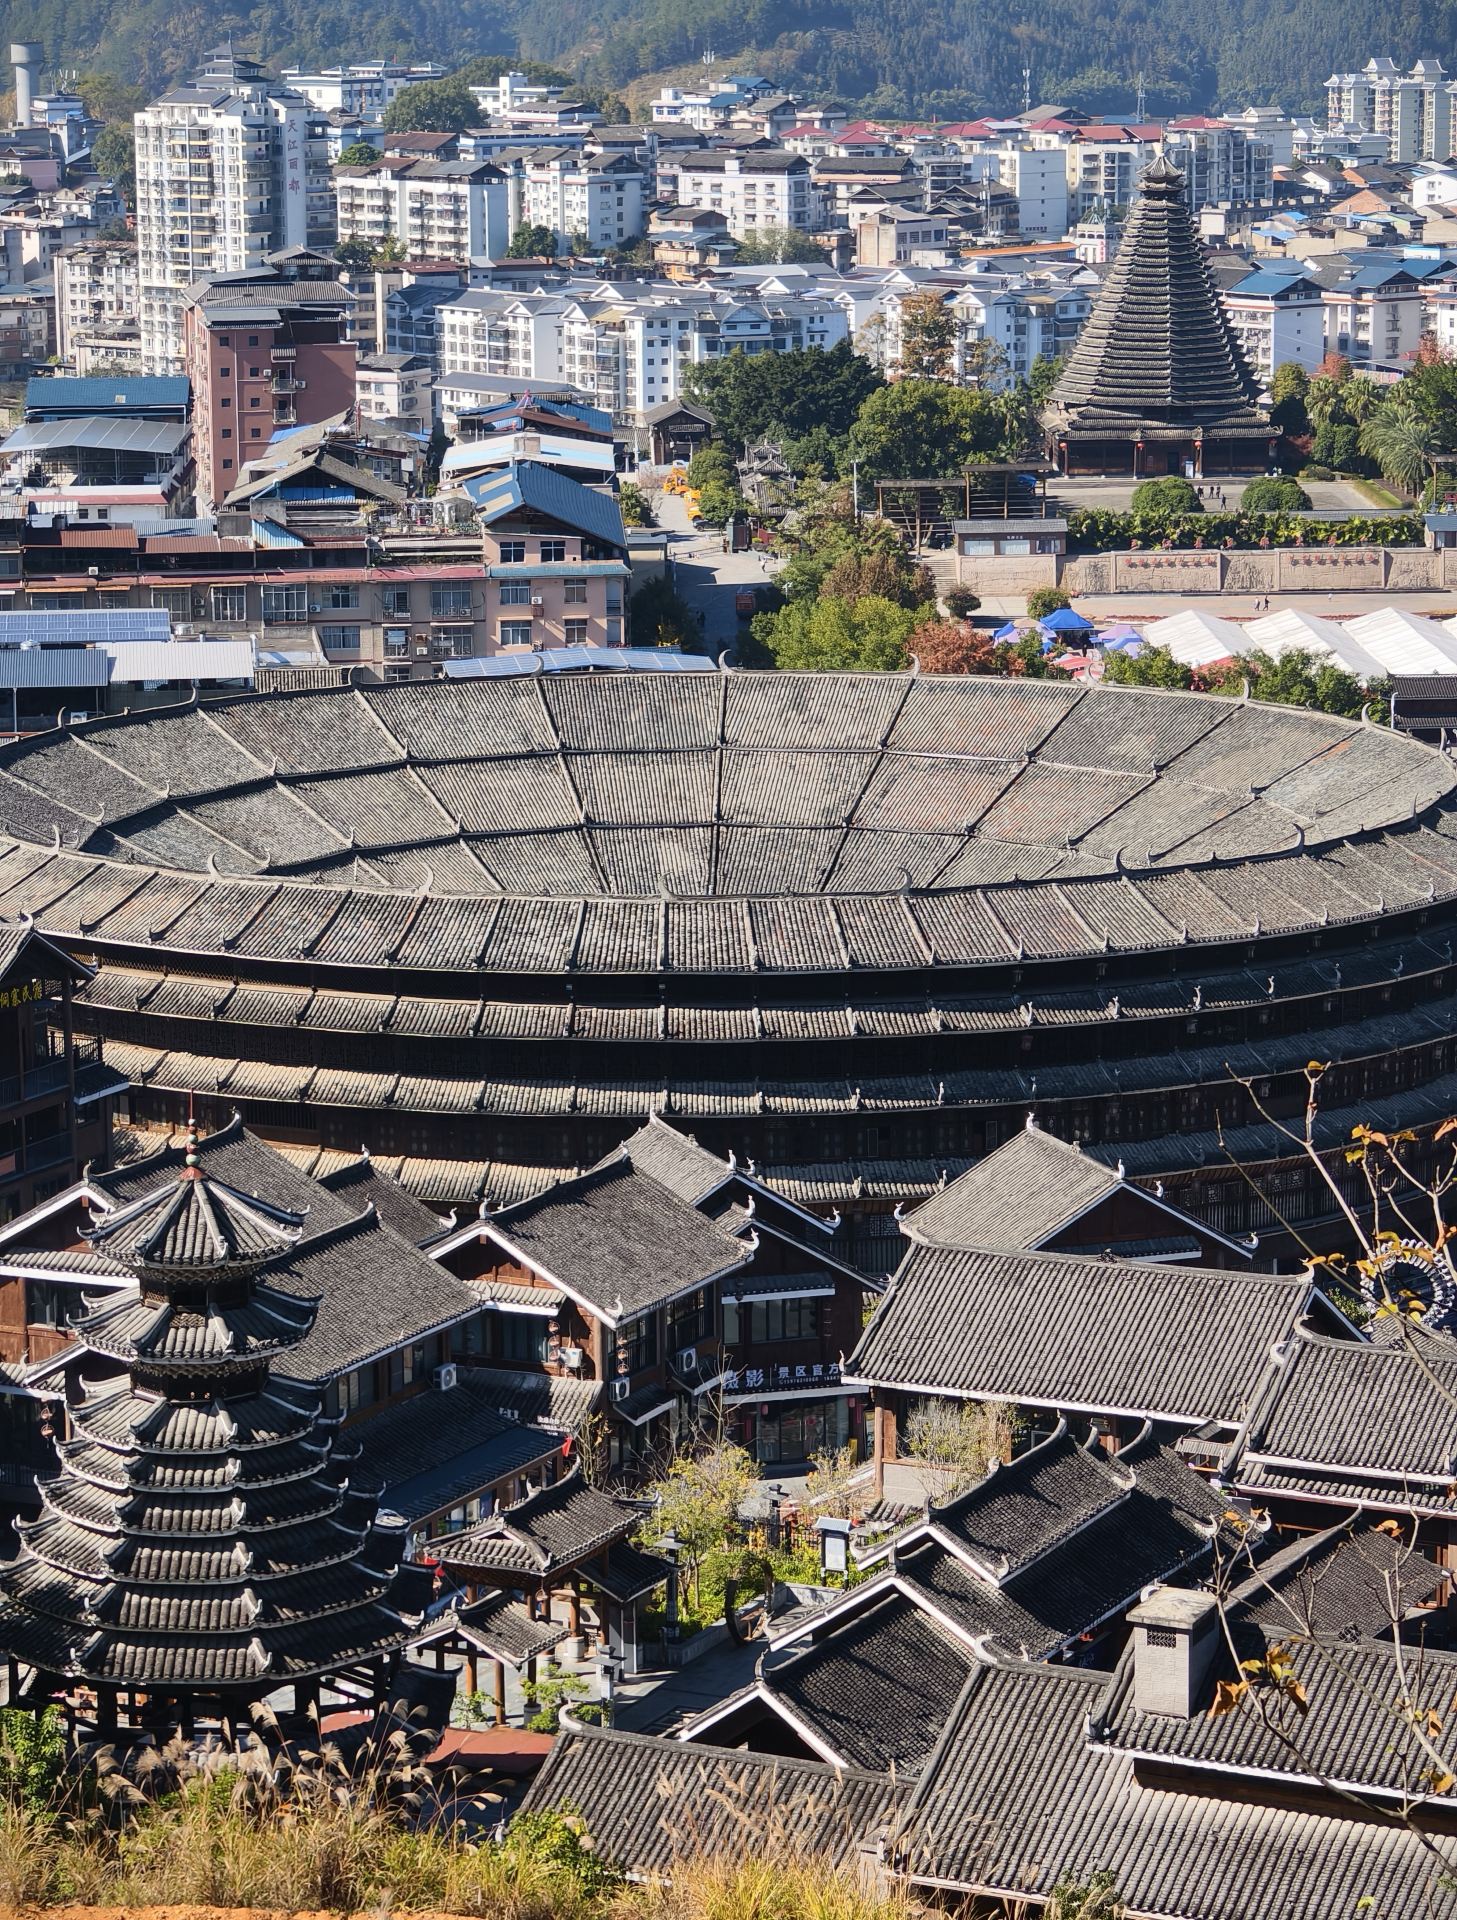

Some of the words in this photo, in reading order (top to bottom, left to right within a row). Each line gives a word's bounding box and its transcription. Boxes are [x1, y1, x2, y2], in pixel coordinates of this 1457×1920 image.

[287, 119, 301, 196] 天江丽都
[722, 1368, 764, 1389] 摄影
[778, 1363, 839, 1378] 景区官方
